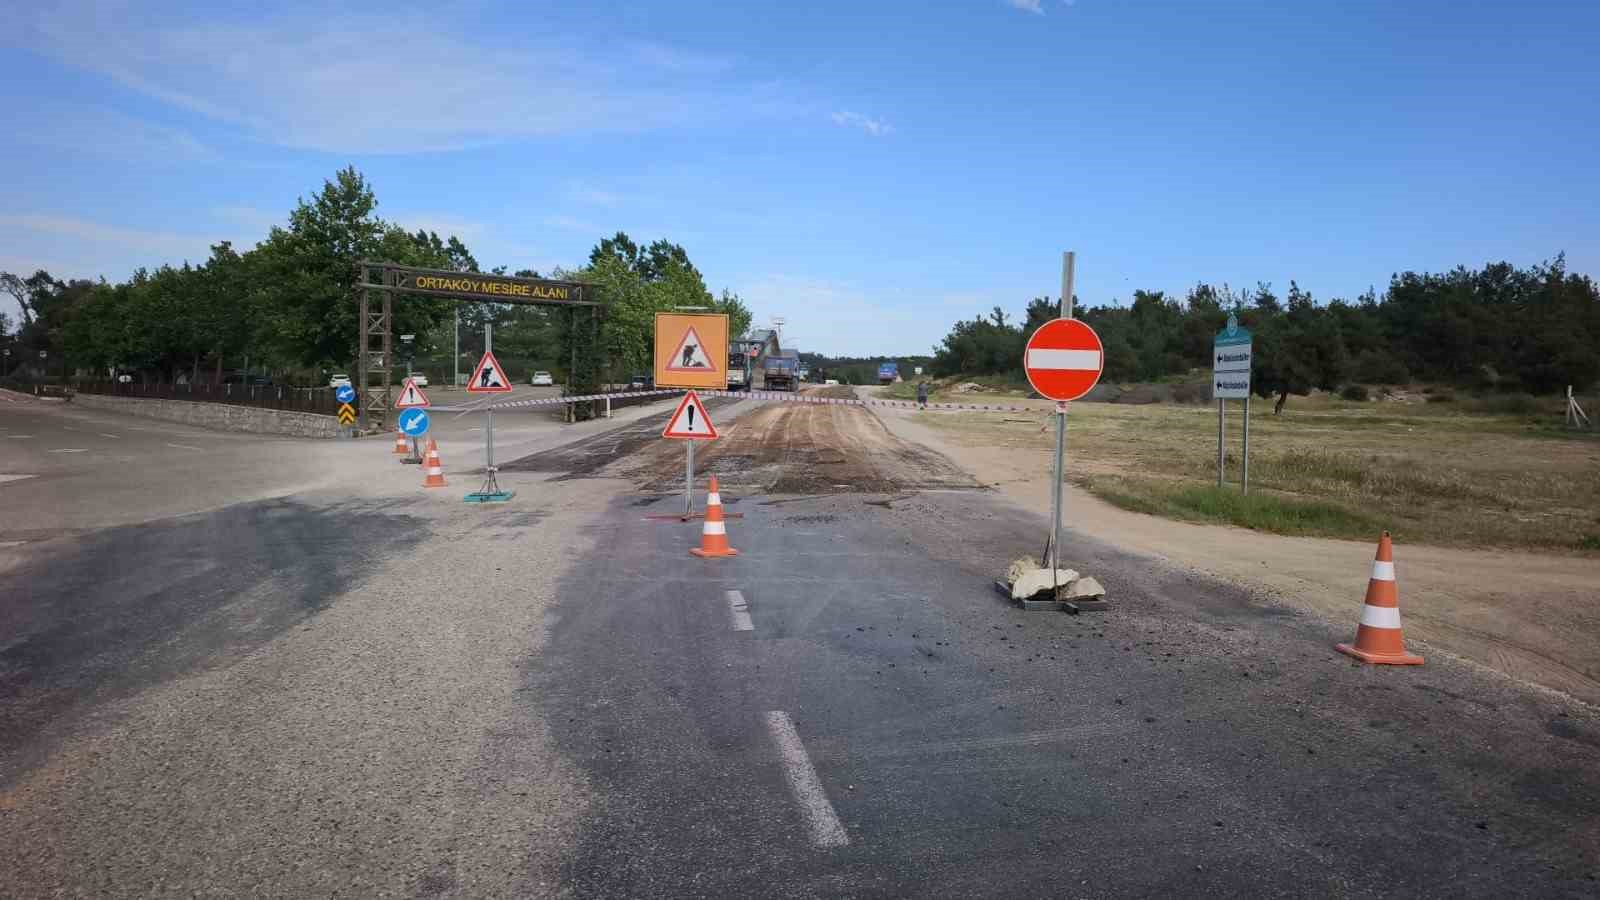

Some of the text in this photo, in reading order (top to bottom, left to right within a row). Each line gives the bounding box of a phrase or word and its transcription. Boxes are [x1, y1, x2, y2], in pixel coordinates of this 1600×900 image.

[416, 276, 569, 299] ORTAKÖY MESİRE ALANI
